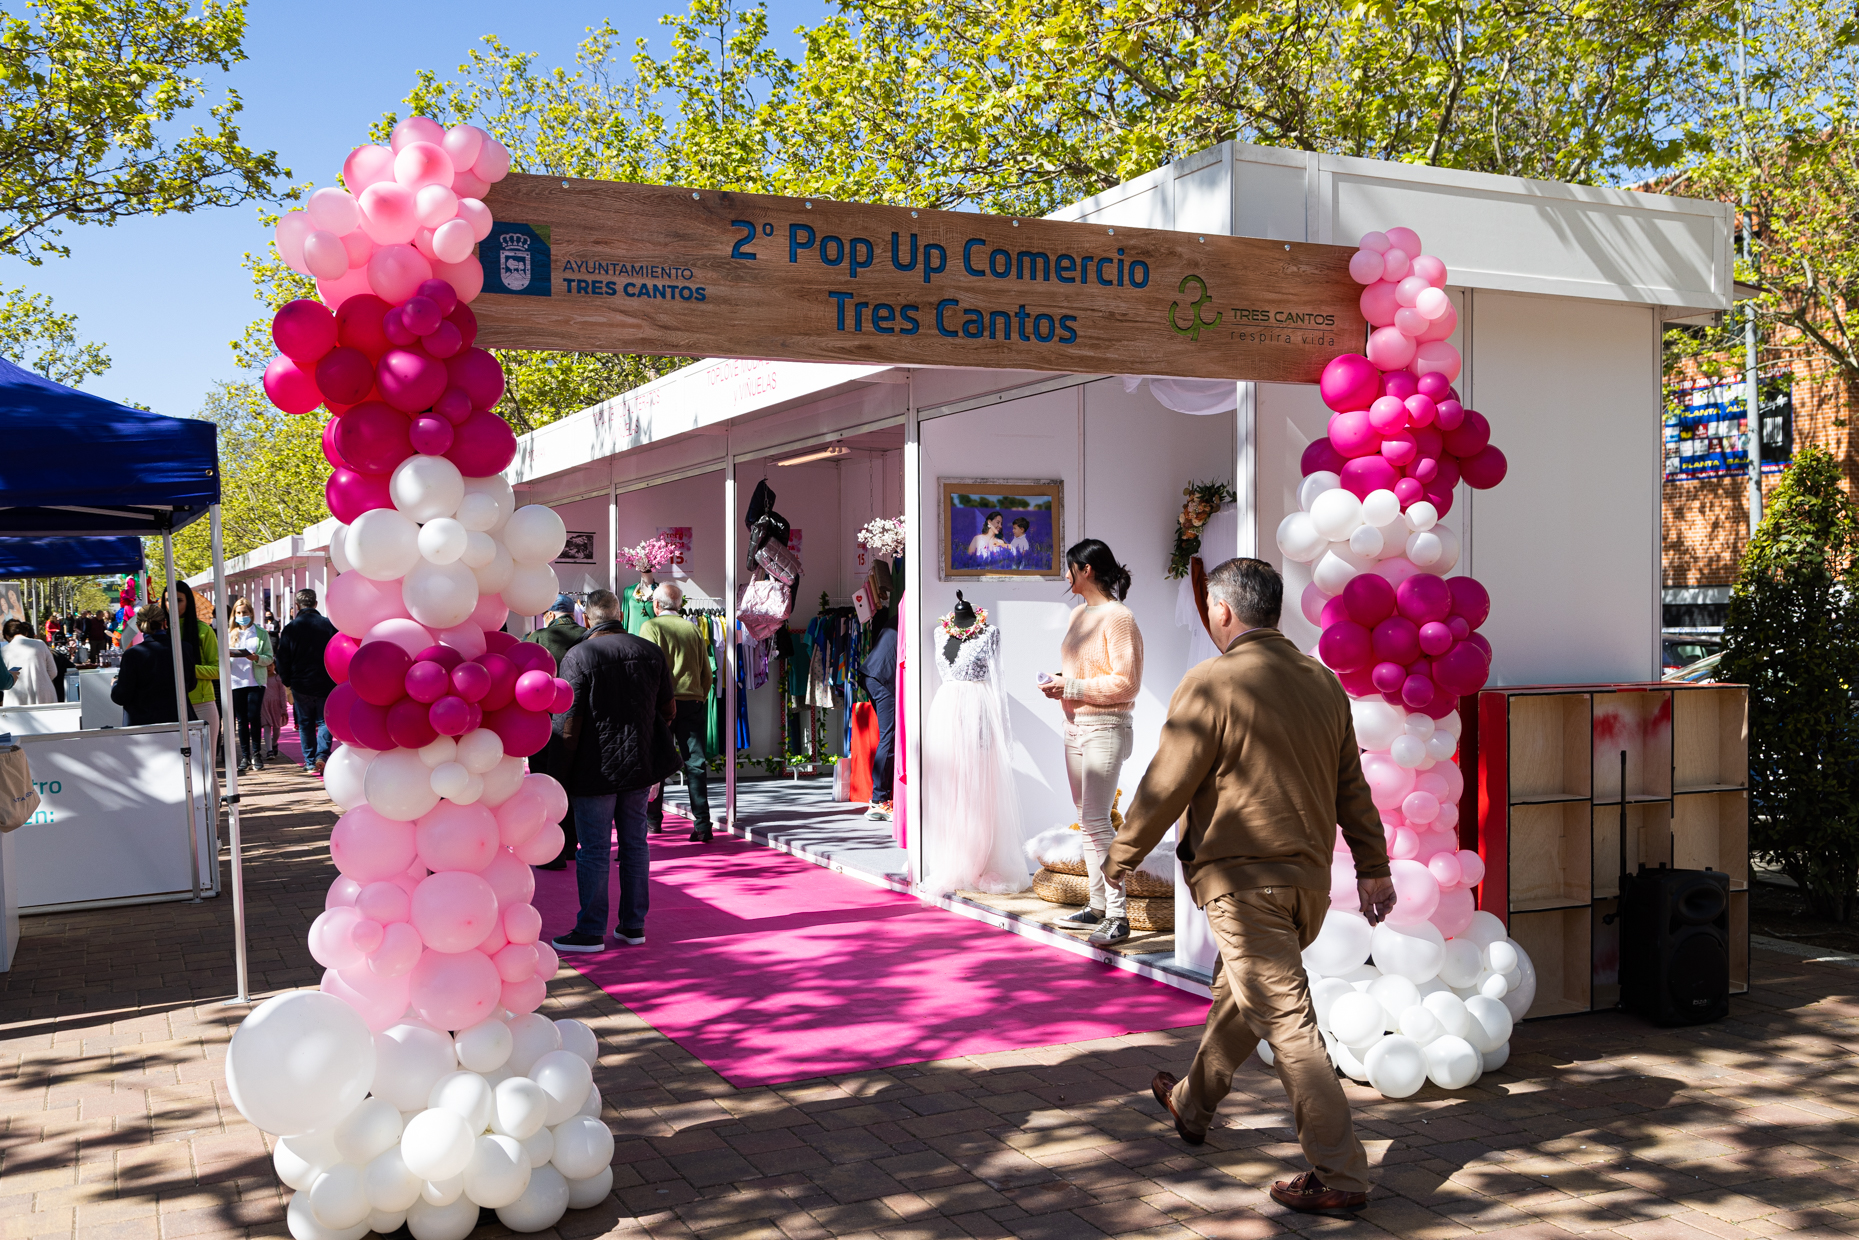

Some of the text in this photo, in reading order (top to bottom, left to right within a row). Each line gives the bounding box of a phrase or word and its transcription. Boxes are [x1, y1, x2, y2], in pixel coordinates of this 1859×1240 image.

[731, 219, 1150, 289] 2º Pop Up Comercio
[562, 259, 694, 281] AYUNTAMIENTO
[562, 278, 707, 302] TRES CANTOS
[828, 290, 1078, 345] Tres Cantos
[1231, 308, 1335, 327] TRES CANTOS
[1230, 330, 1335, 347] respira vida
[706, 359, 739, 387] TOPLOVE
[739, 371, 777, 400] VIÑUELAS
[1681, 408, 1721, 418] PLANTA
[1682, 460, 1720, 469] PLANTA
[857, 553, 866, 566] 15
